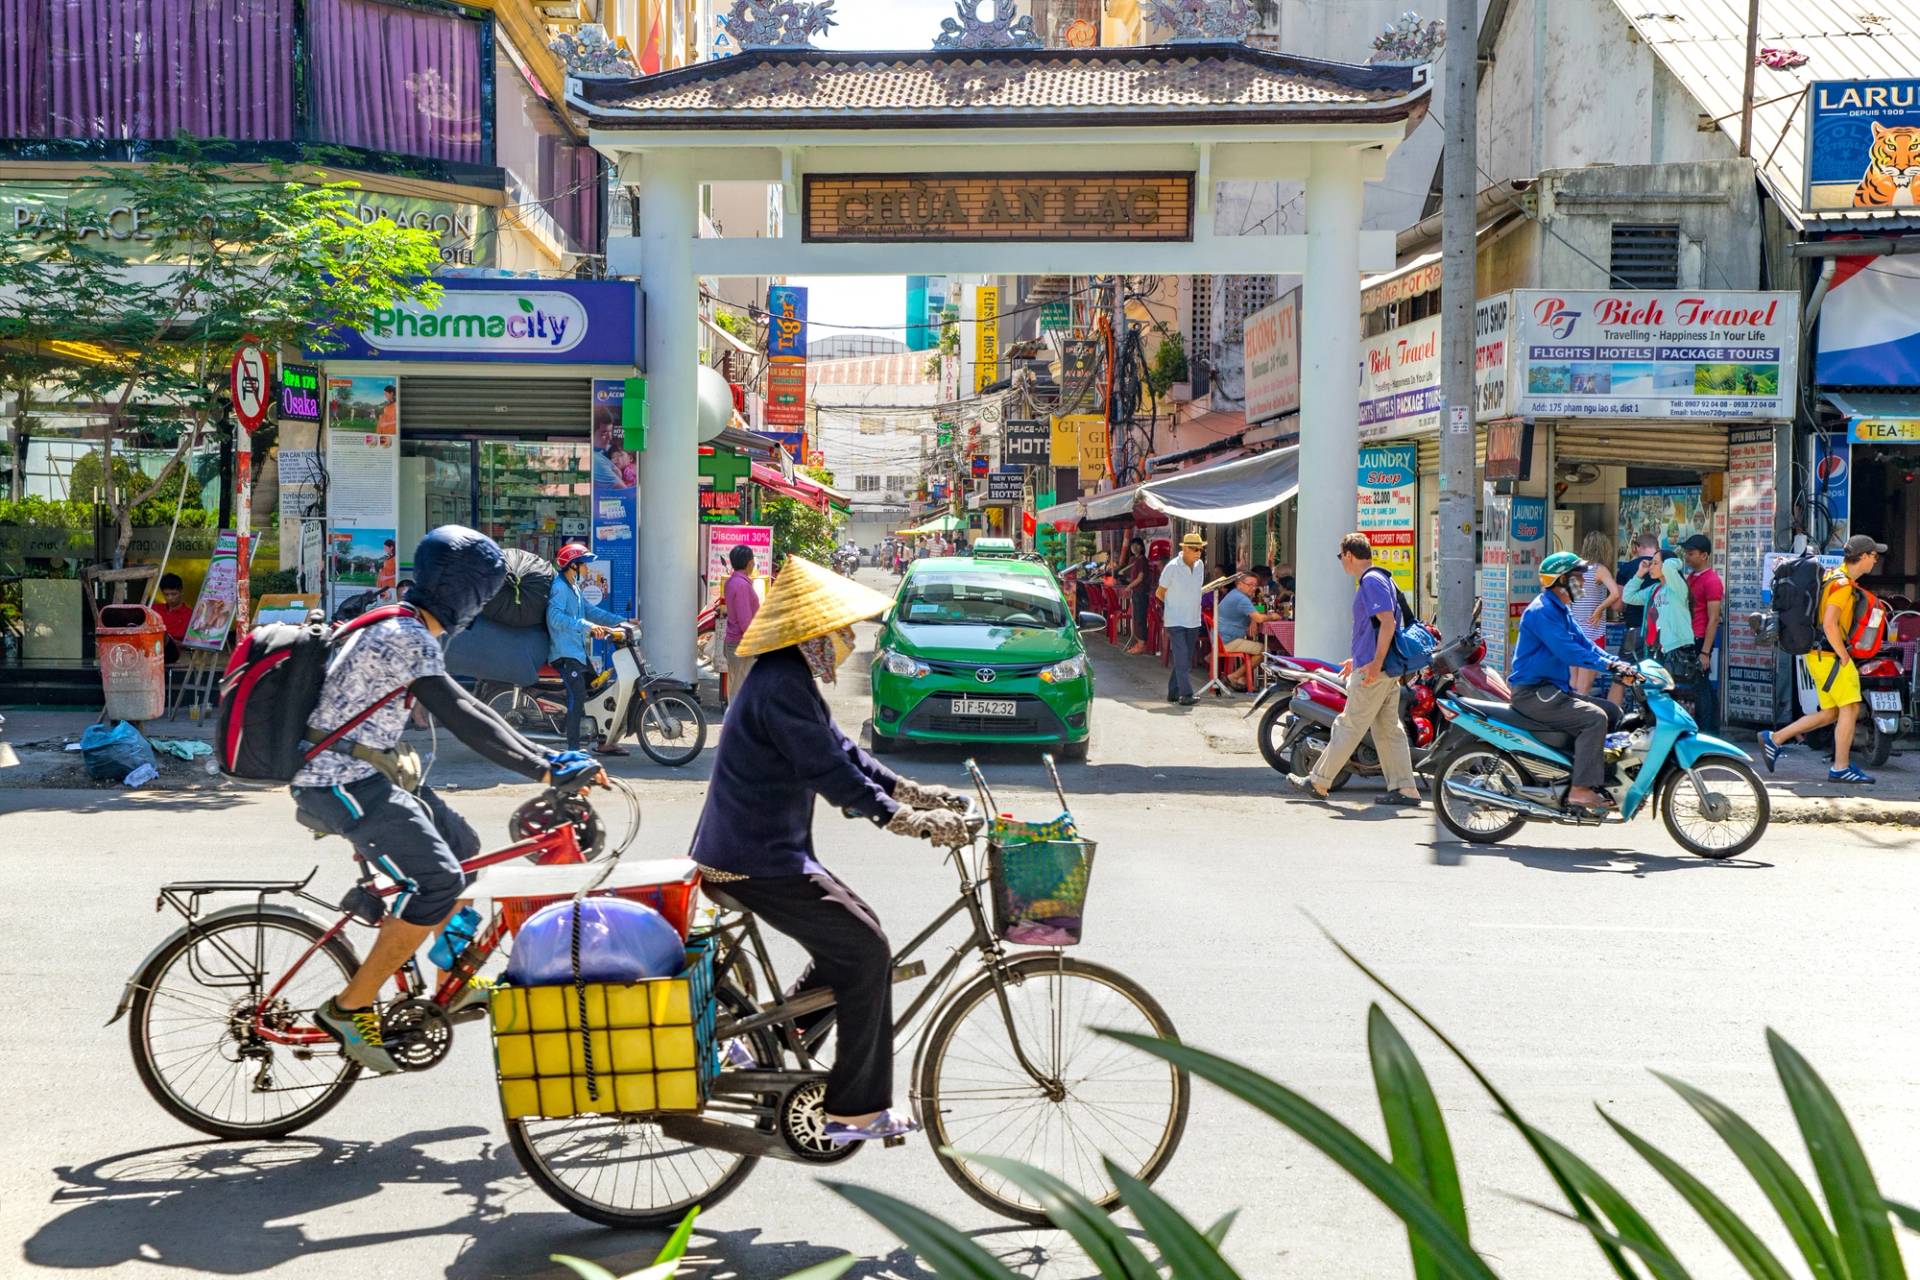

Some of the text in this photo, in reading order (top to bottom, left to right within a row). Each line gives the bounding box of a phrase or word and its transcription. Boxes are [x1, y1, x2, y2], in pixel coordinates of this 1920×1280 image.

[1819, 87, 1920, 109] LARU
[1849, 109, 1880, 117] DEPUIS
[836, 181, 1161, 232] CHÙA AN LẠC
[1490, 301, 1507, 333] SHOP
[1593, 297, 1778, 327] Bich Travel
[373, 305, 569, 346] Pharmacity
[776, 302, 801, 351] Tiger
[1604, 329, 1650, 343] Travelling
[1659, 330, 1707, 343] Happiness
[1710, 330, 1721, 341] In
[1723, 330, 1746, 341] Your
[1747, 331, 1766, 341] Life
[1397, 330, 1437, 367] Travel
[1534, 348, 1775, 360] FLIGHTS HOTELS PACKAGE TOURS
[284, 387, 318, 417] Osaka
[1482, 380, 1504, 412] SHOP
[1531, 402, 1547, 412] Add:
[1549, 402, 1562, 412] 175
[1564, 402, 1583, 413] pham
[1584, 403, 1596, 414] ngu
[1619, 403, 1633, 413] dist
[1358, 452, 1411, 468] LAUNDRY
[1367, 471, 1402, 485] Shop
[1513, 504, 1543, 521] LAUNDRY
[712, 530, 770, 543] Discount 30%
